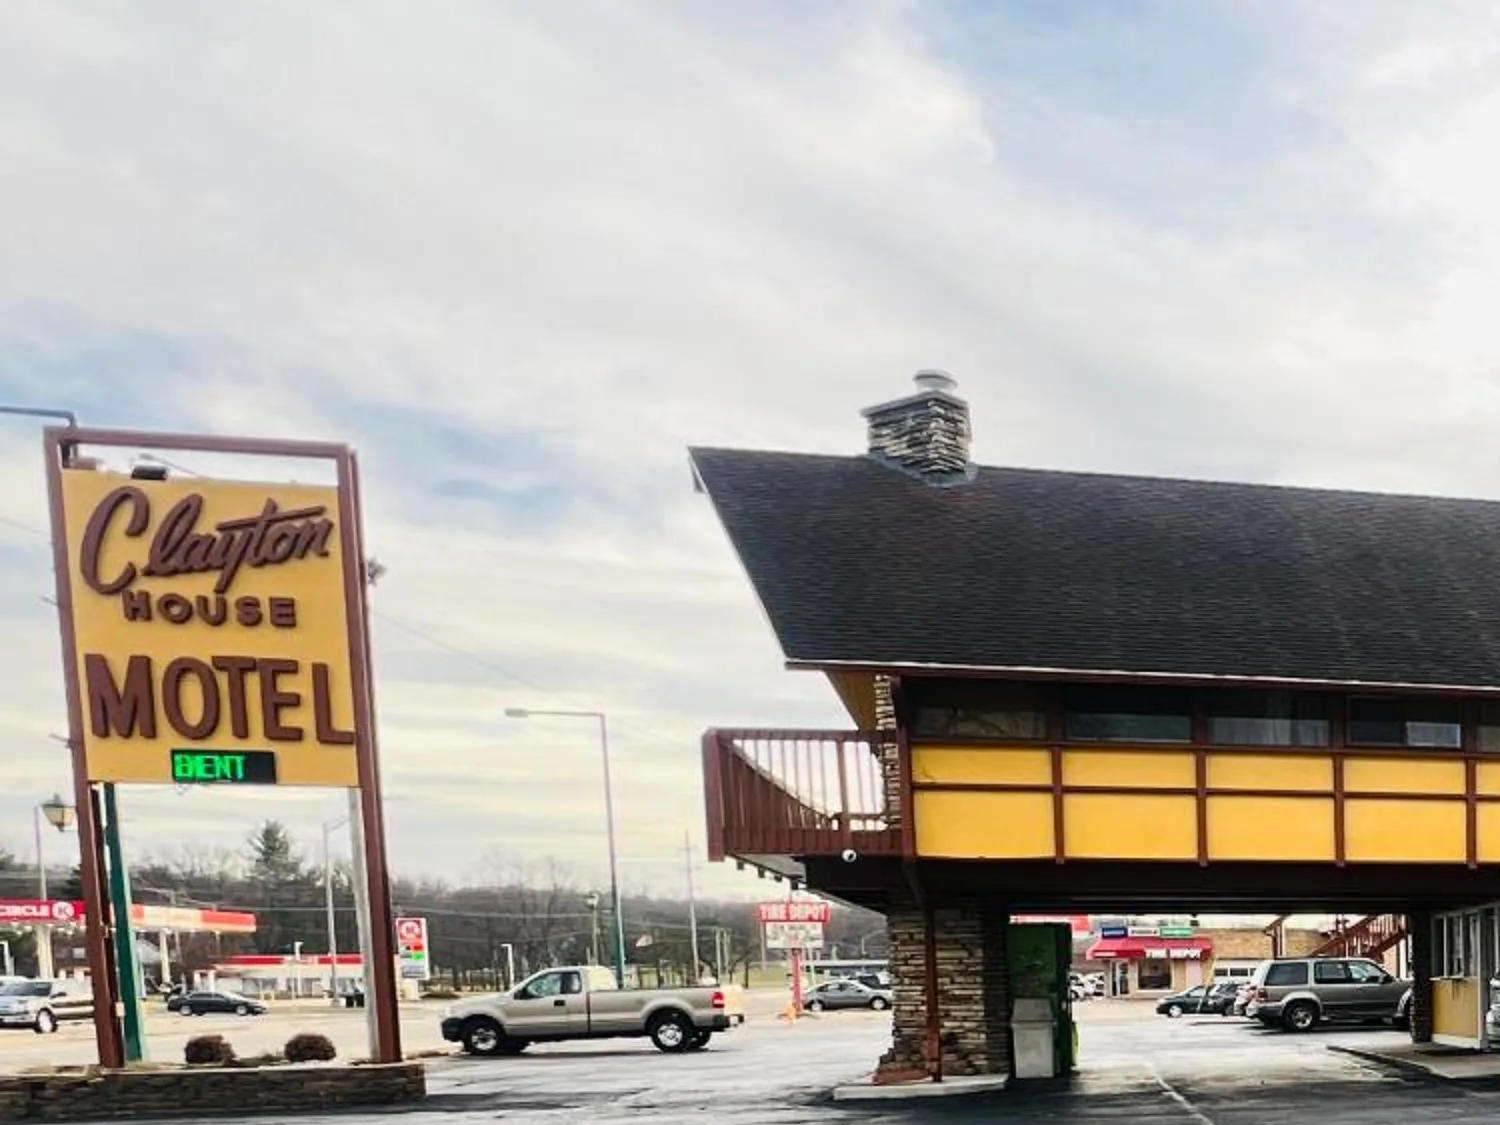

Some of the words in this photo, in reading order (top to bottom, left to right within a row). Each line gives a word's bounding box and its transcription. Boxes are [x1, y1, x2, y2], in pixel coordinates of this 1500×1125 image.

[80, 486, 334, 594] Clayton
[122, 591, 297, 628] HOUSE
[84, 653, 356, 745] MOTEL
